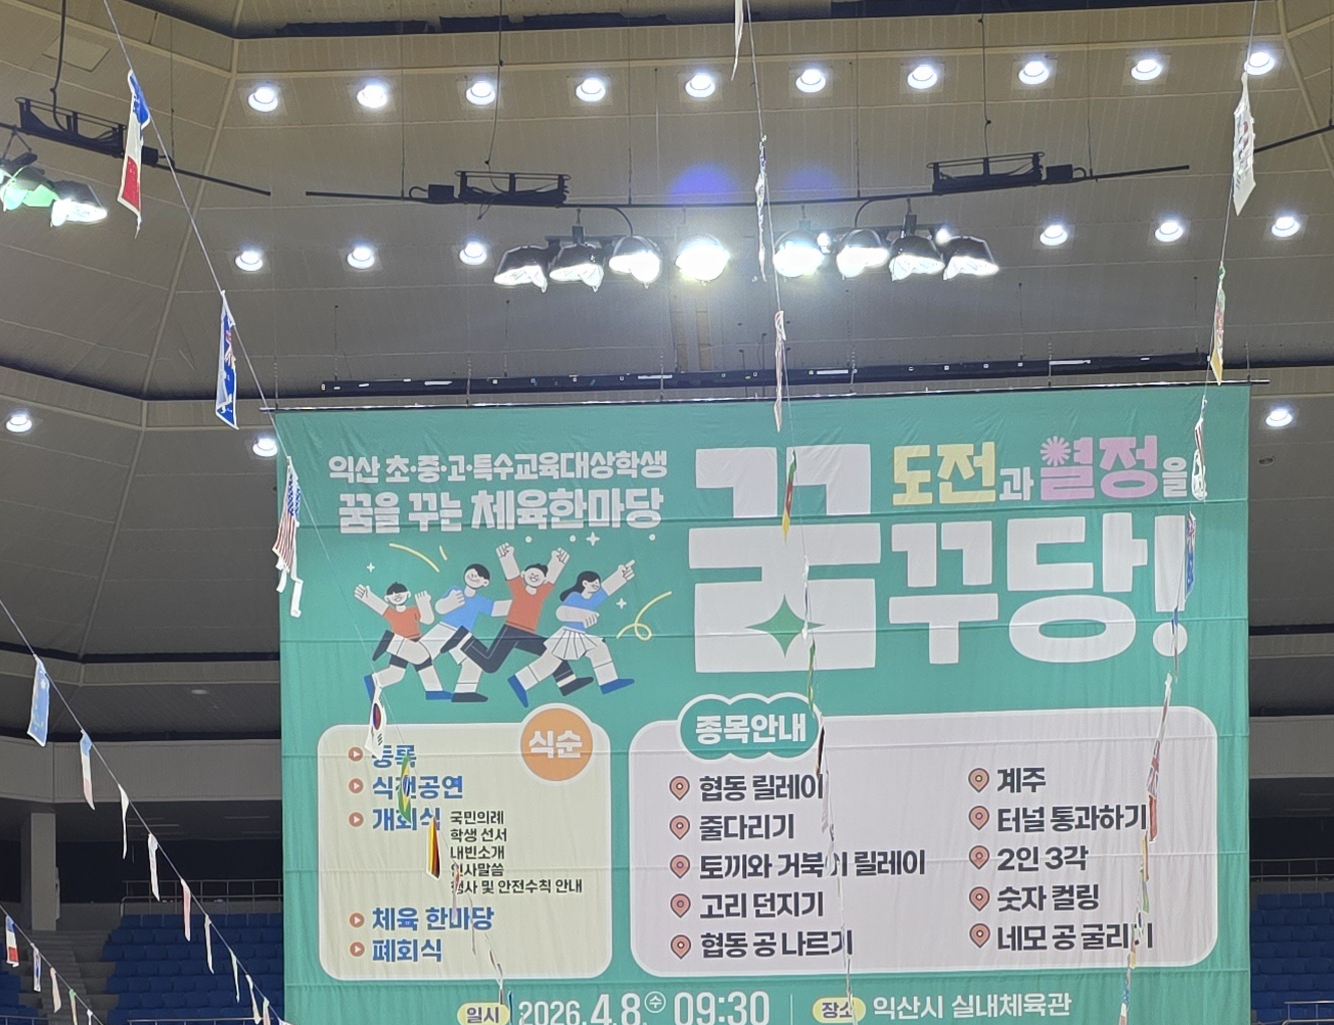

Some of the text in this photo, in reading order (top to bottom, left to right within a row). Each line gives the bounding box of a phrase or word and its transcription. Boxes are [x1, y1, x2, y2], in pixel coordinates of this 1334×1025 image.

[329, 456, 379, 483] 익산
[893, 442, 1034, 505] 도전과
[339, 487, 664, 534] 꿈을 꾸는 체육한마당
[689, 444, 1187, 673] 꿈꾸당!
[695, 713, 806, 744] 종목안내
[529, 730, 583, 758] 식순
[699, 774, 823, 801] 협동 릴레이
[997, 768, 1046, 793] 계주
[450, 811, 504, 825] 국민의례
[699, 814, 794, 841] 줄다리기
[997, 805, 1146, 832] 터널 통과하기
[450, 829, 507, 842] 학생 선서
[450, 847, 505, 860] 내빈소개
[700, 854, 772, 879] 토끼와
[855, 850, 925, 876] 릴레이
[997, 846, 1088, 871] 2인 3각
[482, 881, 494, 894] 및
[498, 880, 551, 893] 안전수칙
[555, 879, 582, 893] 안내
[997, 884, 1099, 912] 숫자 컬링
[699, 892, 823, 918] 고리 던지기
[373, 908, 494, 931] 체육 한마당
[373, 940, 441, 962] 폐회식
[701, 930, 853, 958] 협동 공 나르기
[997, 926, 1046, 950] 네모
[1052, 925, 1076, 950] 공
[466, 1006, 500, 1024] 일시
[821, 992, 1072, 1020] 장소 익산시 실내체육관
